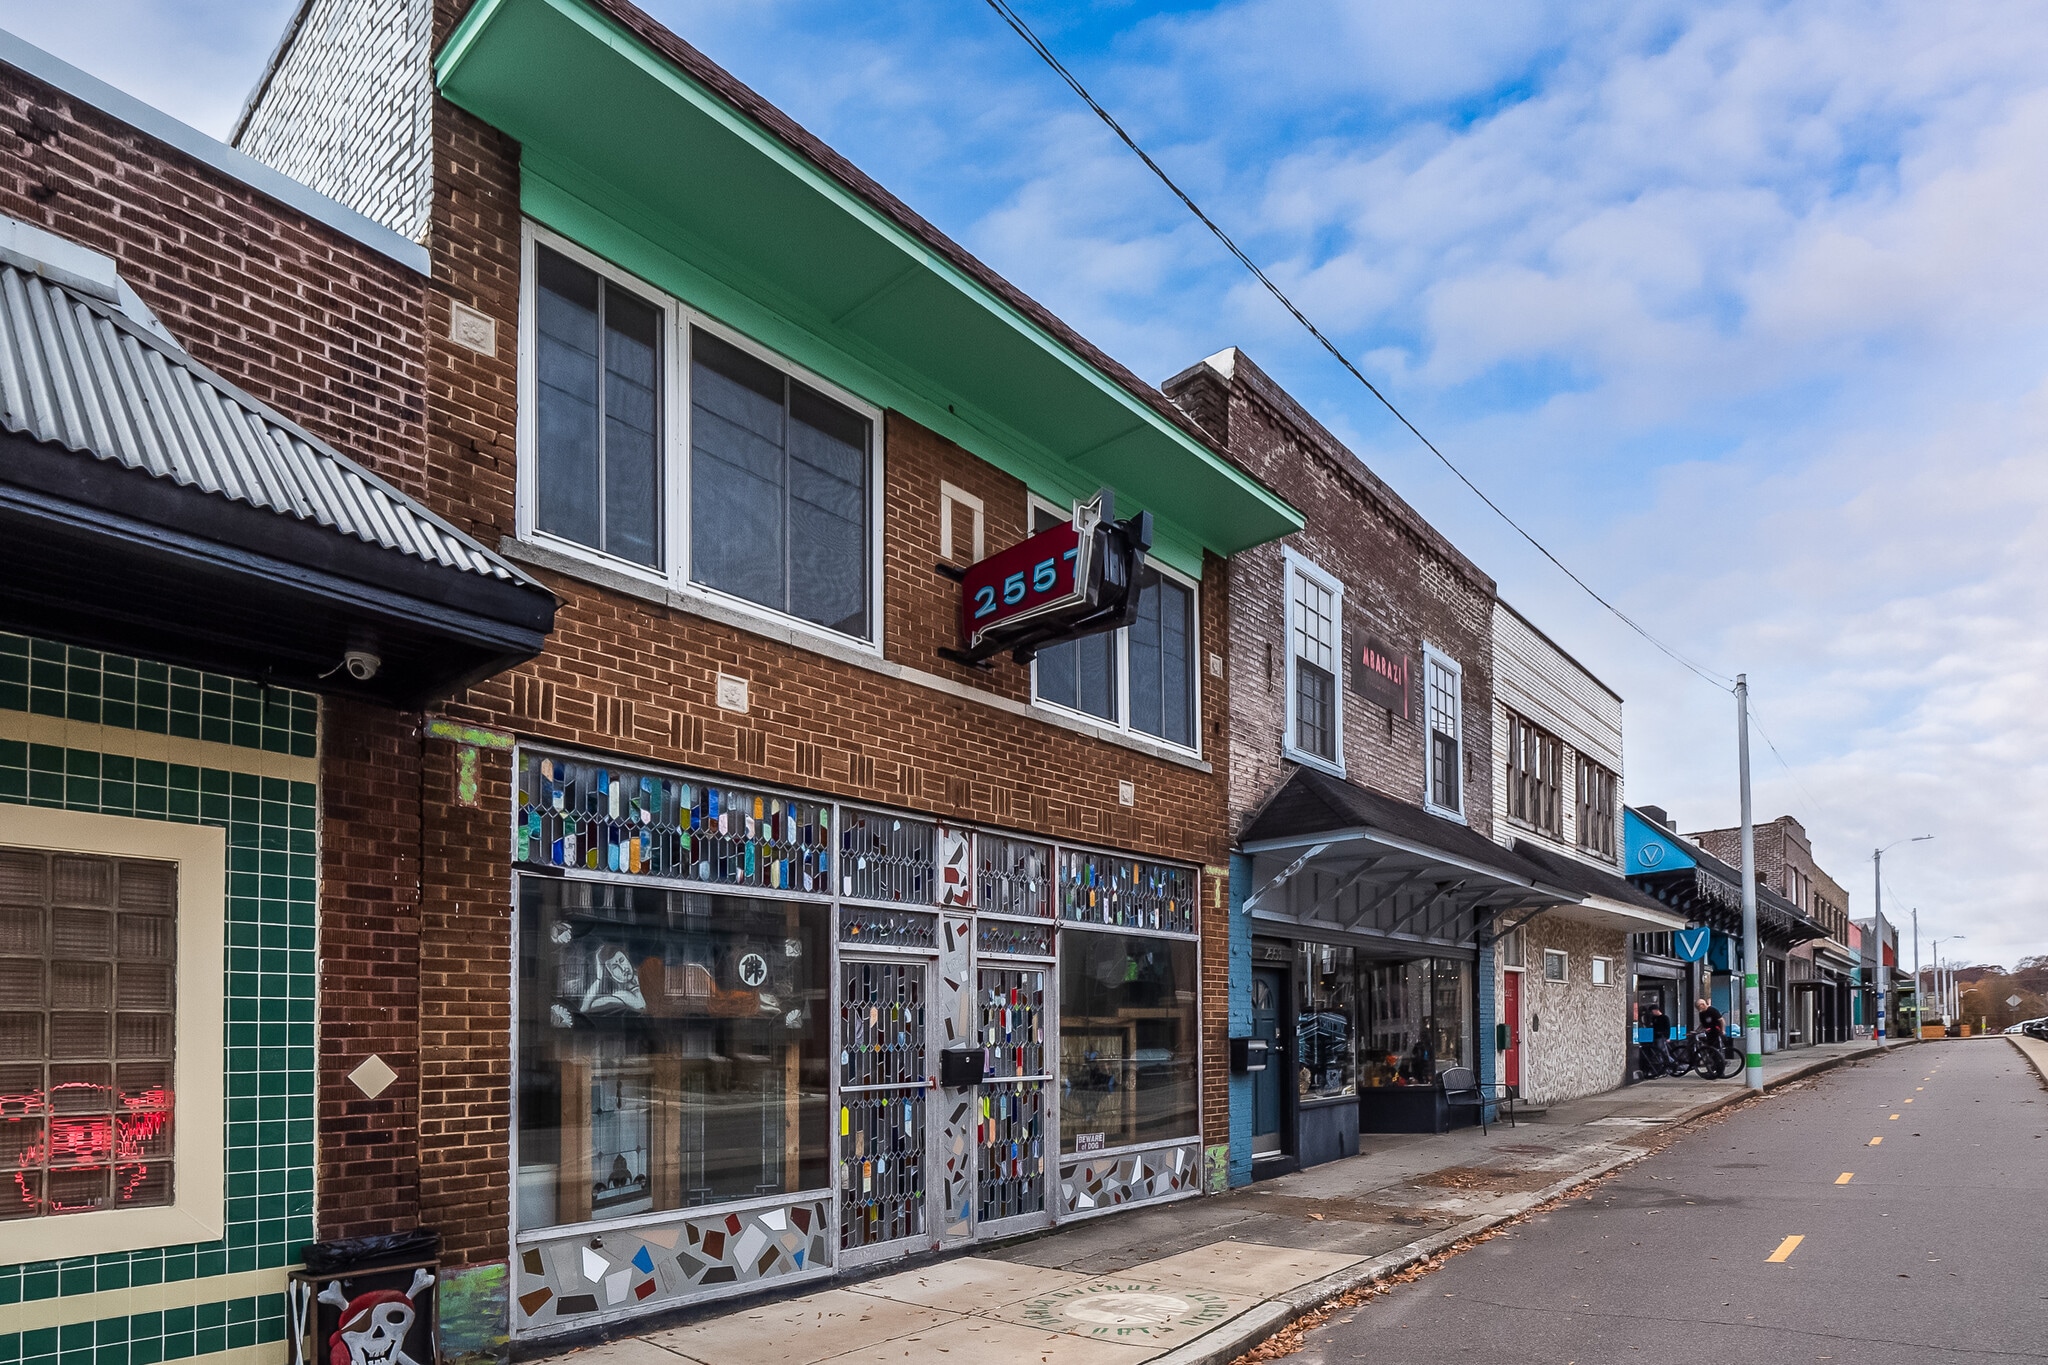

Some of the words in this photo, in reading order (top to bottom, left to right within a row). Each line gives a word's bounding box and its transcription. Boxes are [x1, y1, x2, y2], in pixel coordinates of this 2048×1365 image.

[974, 547, 1079, 619] 2557
[1363, 646, 1402, 686] MBABAZI
[1643, 848, 1659, 863] V
[1679, 930, 1705, 958] V
[1078, 1134, 1103, 1144] BEWARE
[1081, 1142, 1087, 1150] of
[1087, 1141, 1100, 1150] DOG
[1052, 1284, 1159, 1298] AVENUE
